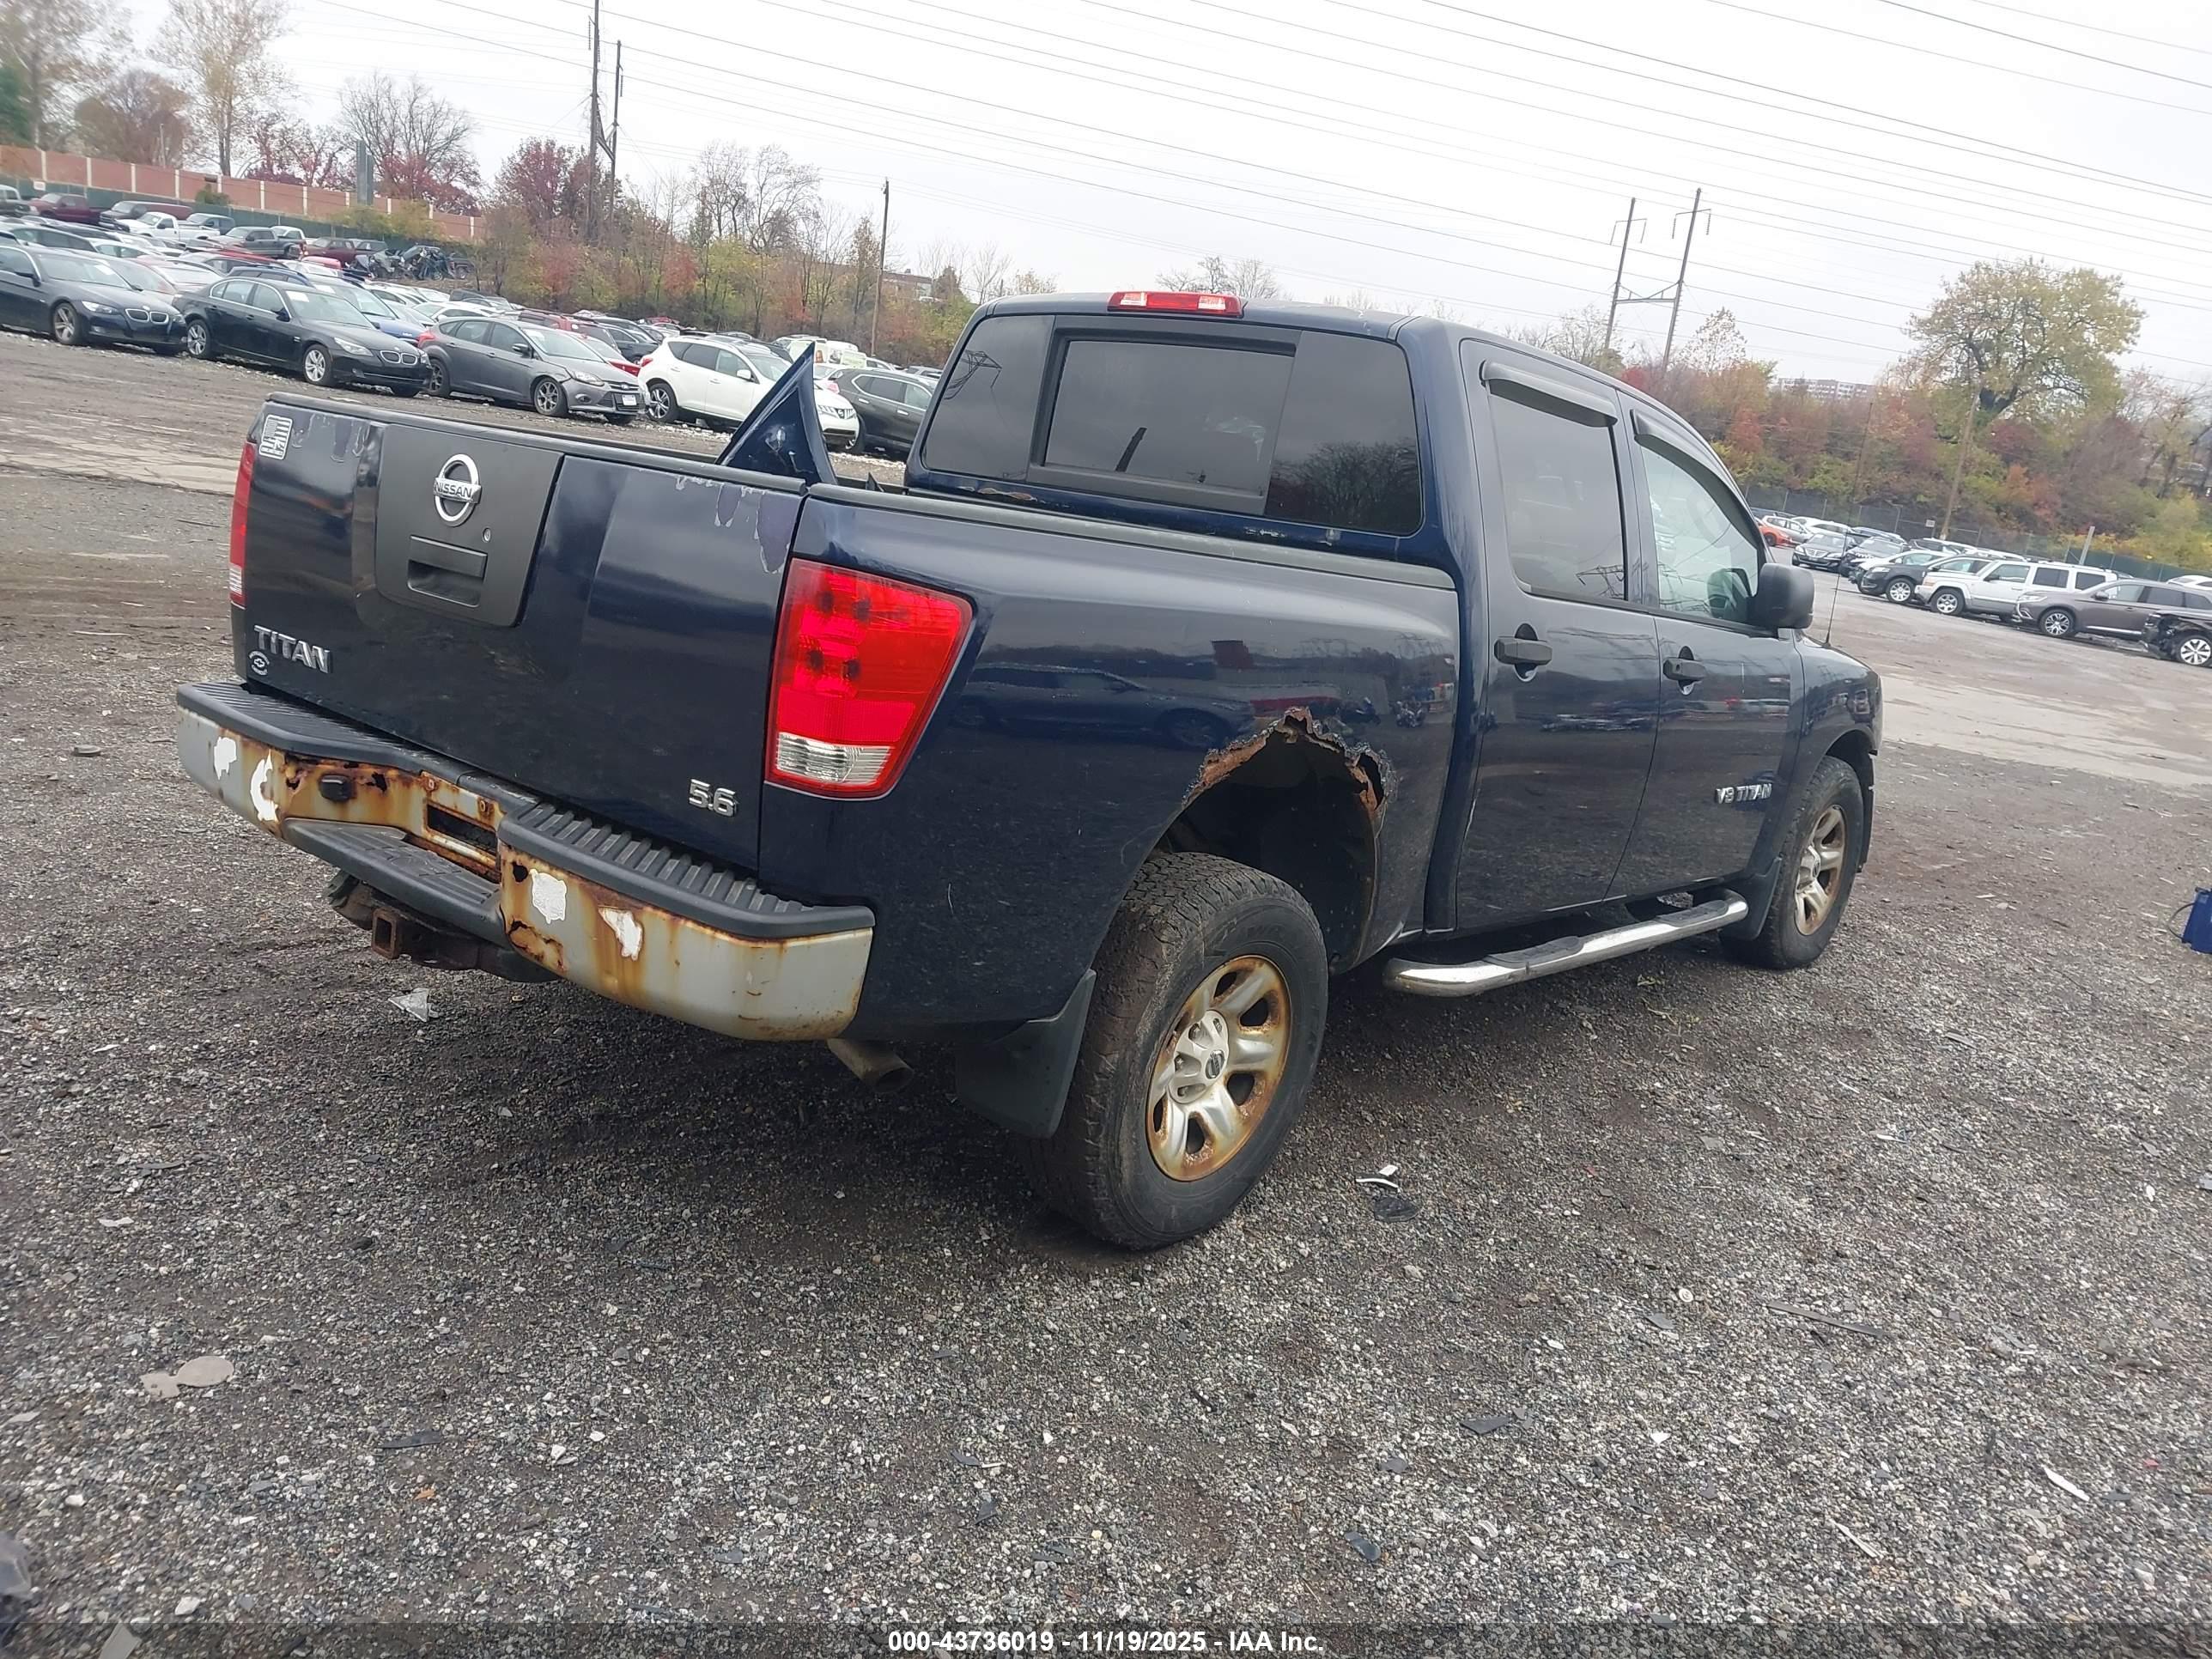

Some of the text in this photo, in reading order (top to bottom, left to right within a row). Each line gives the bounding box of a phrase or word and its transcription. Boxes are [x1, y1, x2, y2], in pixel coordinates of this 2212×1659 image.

[434, 481, 472, 498] NISSAN
[253, 624, 332, 674] TITAN
[689, 778, 738, 817] 5.6
[1736, 783, 1772, 802] TITAN
